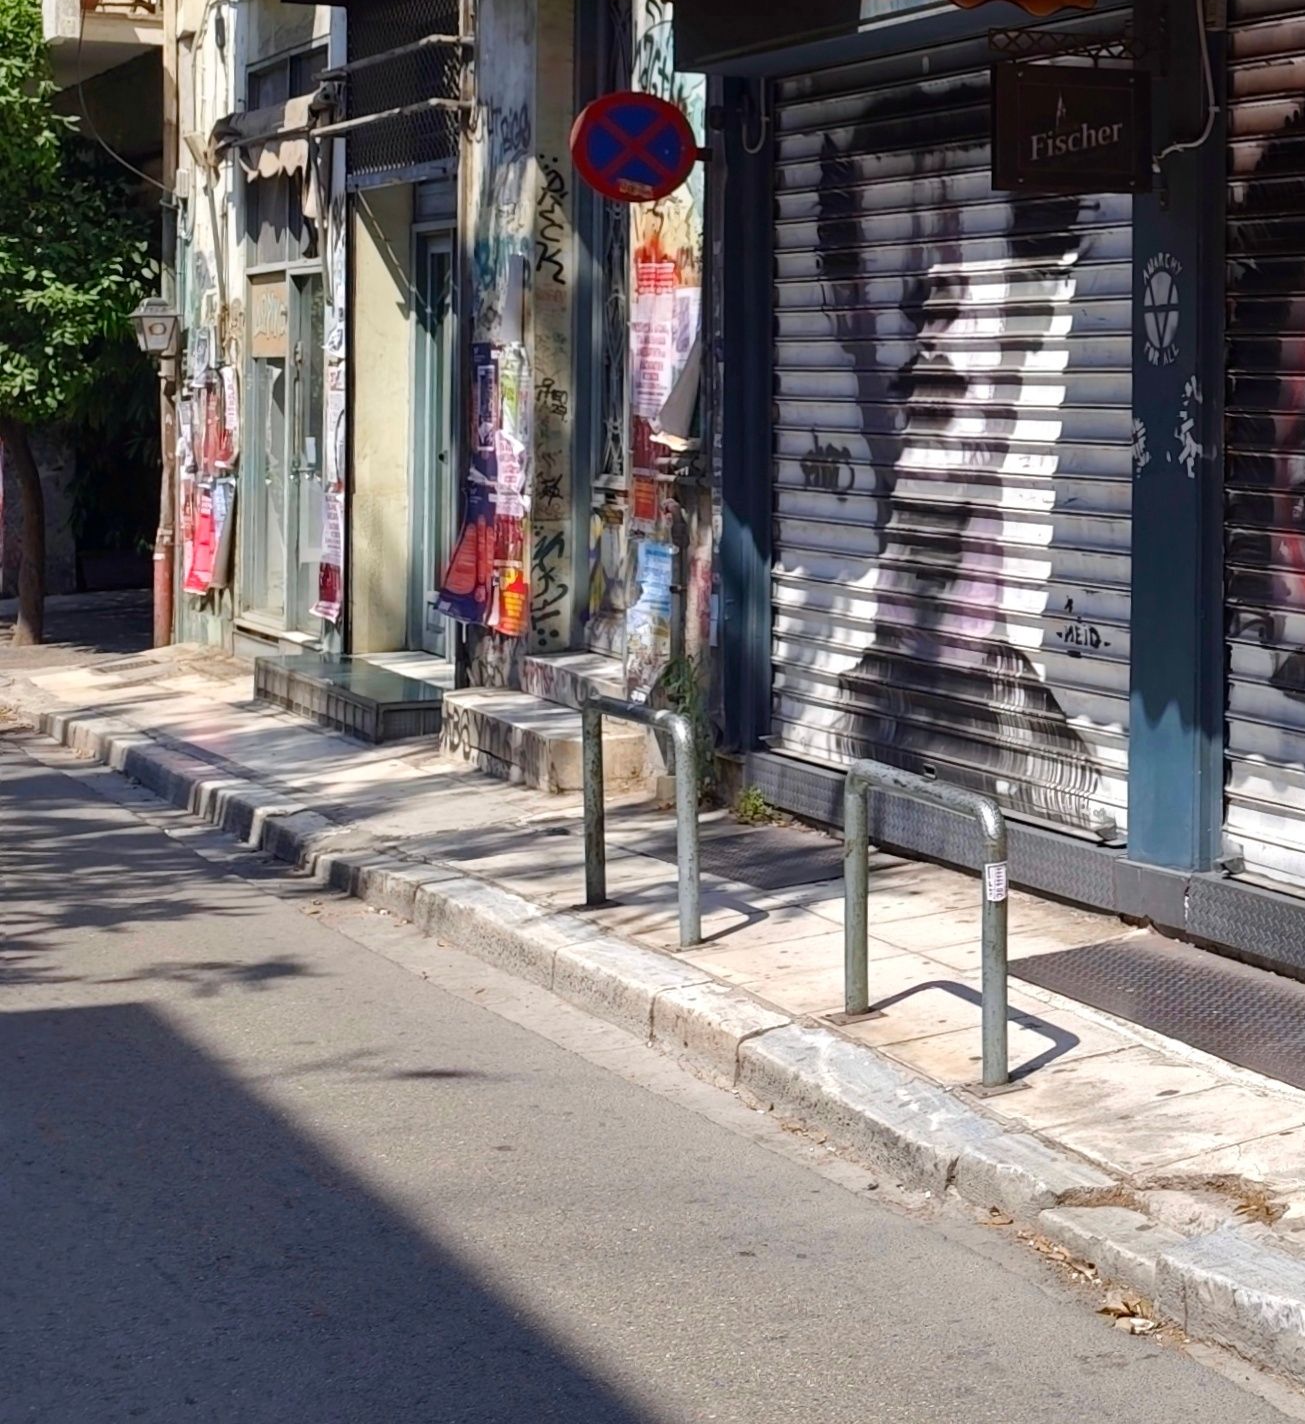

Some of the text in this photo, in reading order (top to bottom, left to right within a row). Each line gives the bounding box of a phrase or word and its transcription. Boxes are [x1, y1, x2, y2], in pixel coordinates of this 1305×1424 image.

[1030, 122, 1123, 161] Fischer
[1143, 252, 1183, 286] ANARCHY
[1162, 343, 1180, 367] ALL
